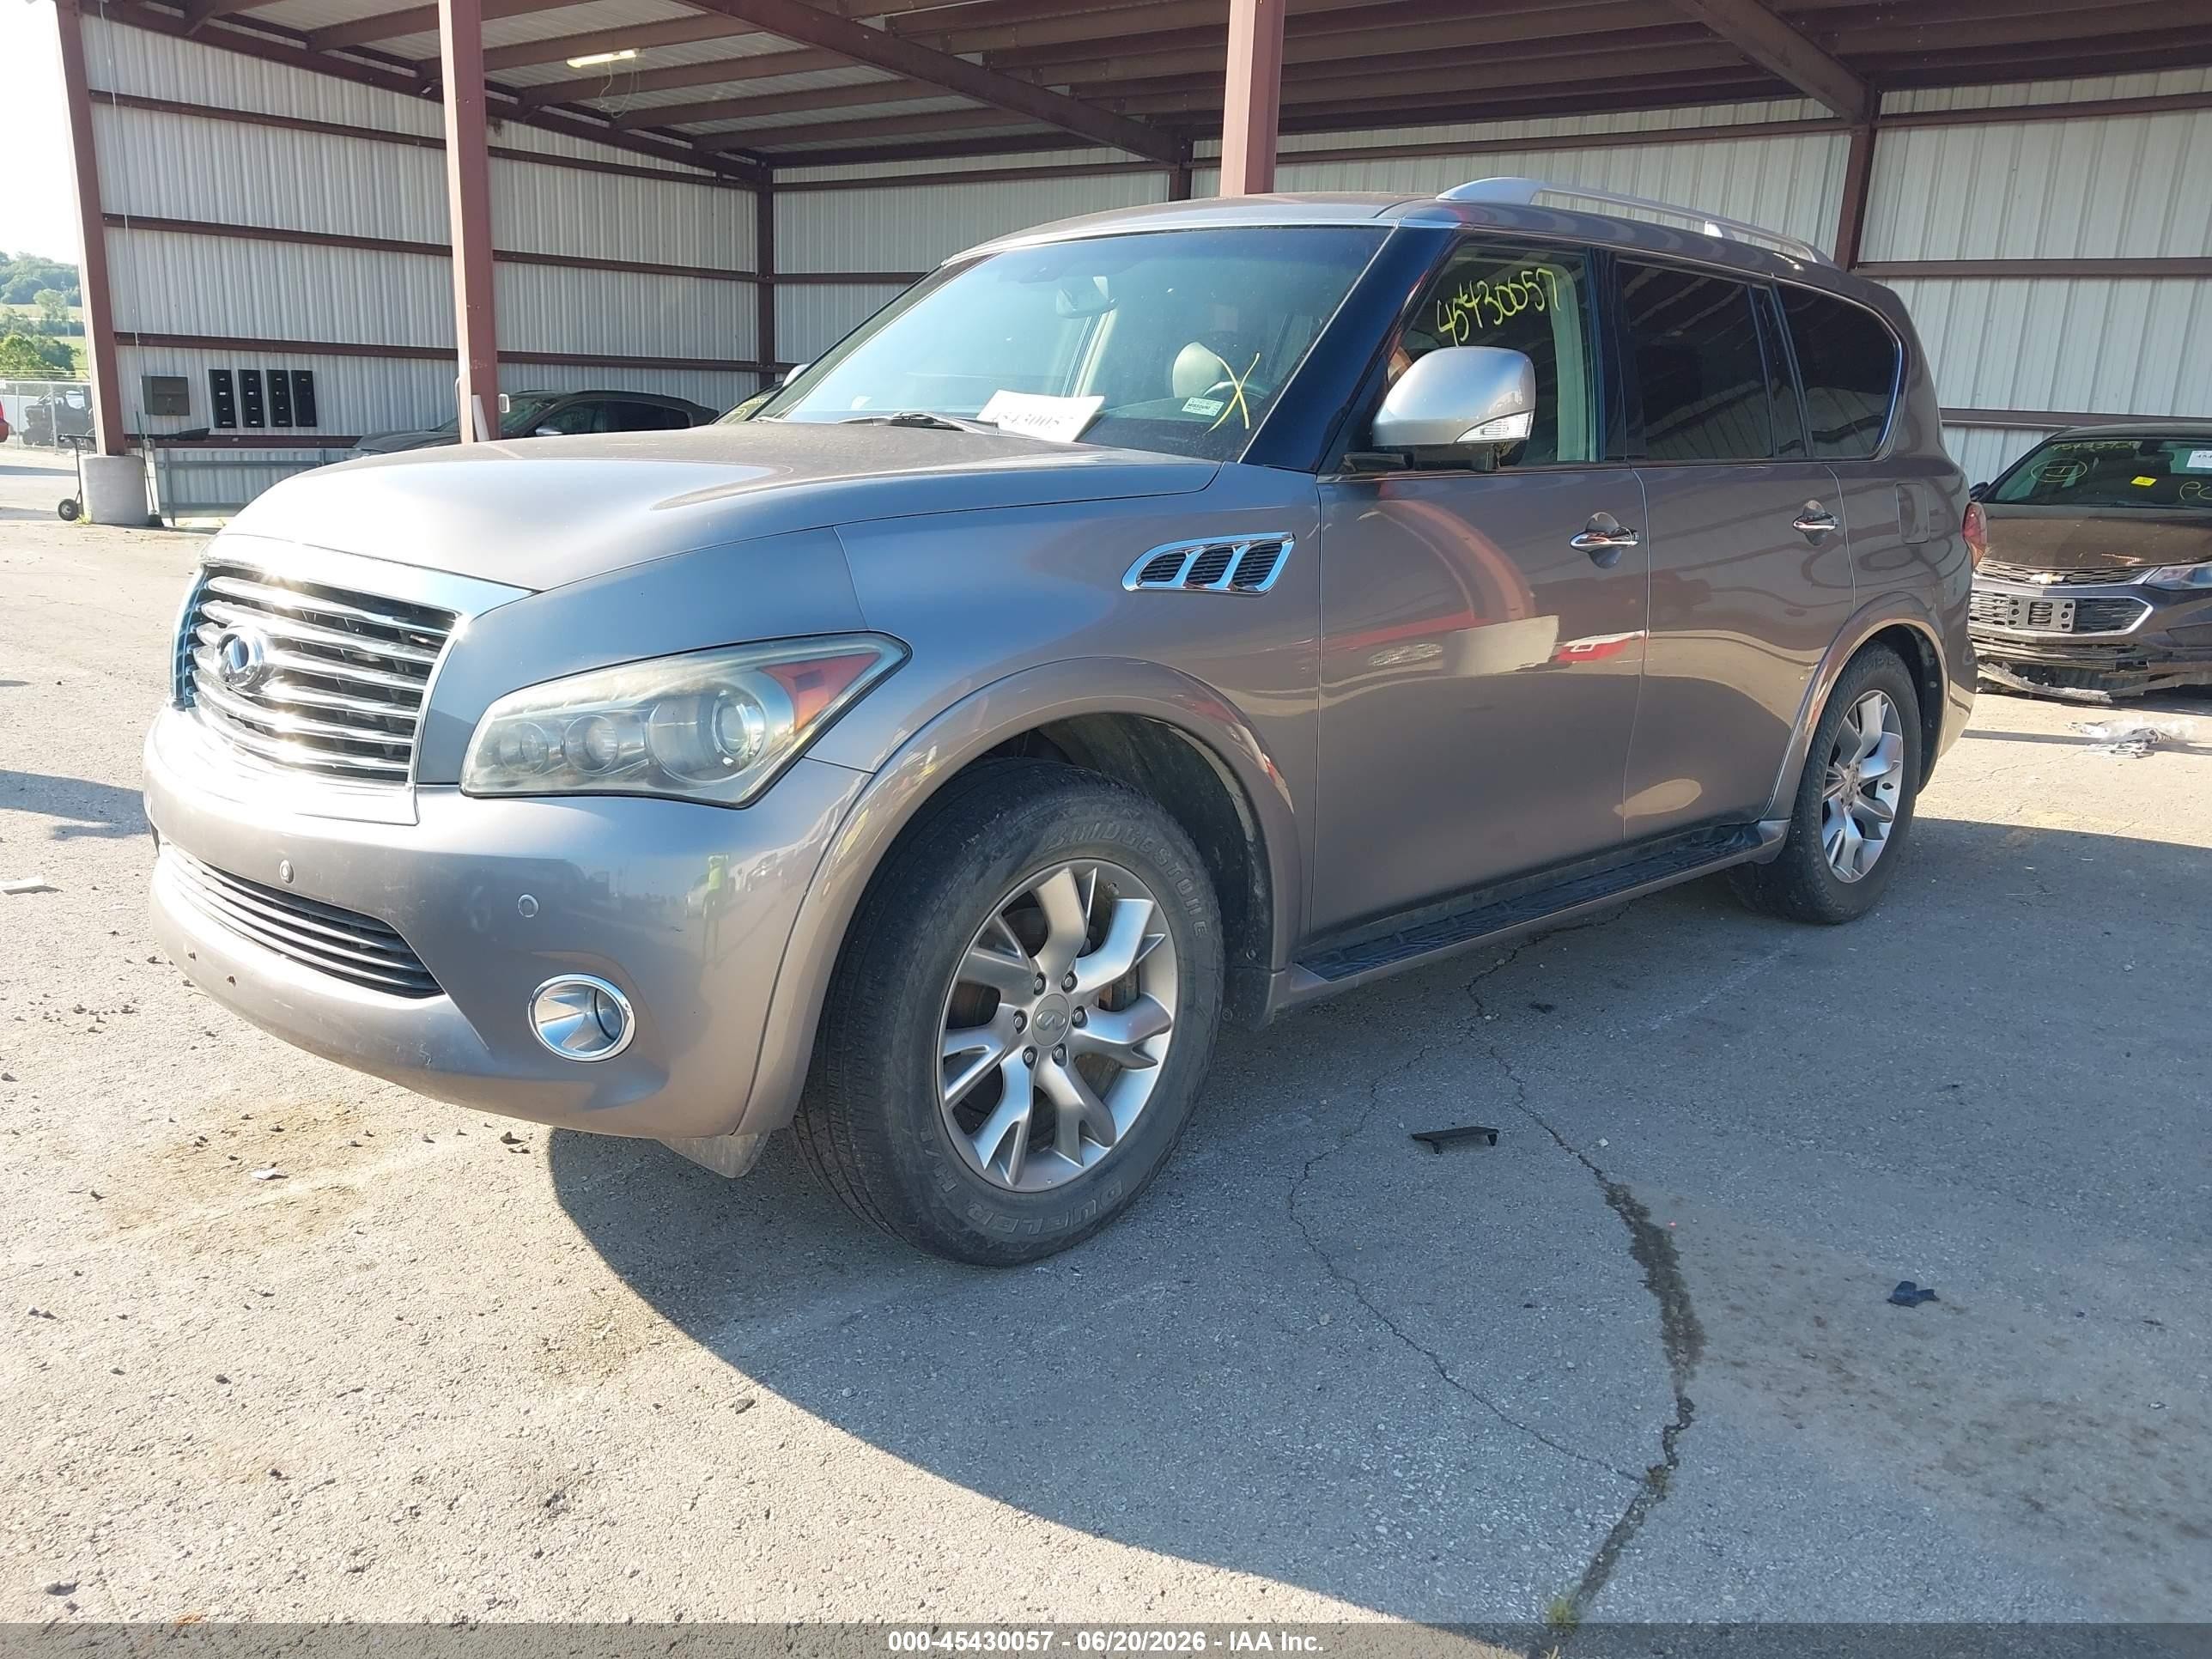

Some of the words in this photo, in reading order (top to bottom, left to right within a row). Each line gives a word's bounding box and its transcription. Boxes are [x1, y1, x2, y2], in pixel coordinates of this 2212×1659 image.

[1437, 268, 1561, 347] 45430057
[989, 411, 1075, 428] 4543005
[1043, 820, 1209, 938] BRIDGESTONE
[967, 1178, 1124, 1235] DUELER
